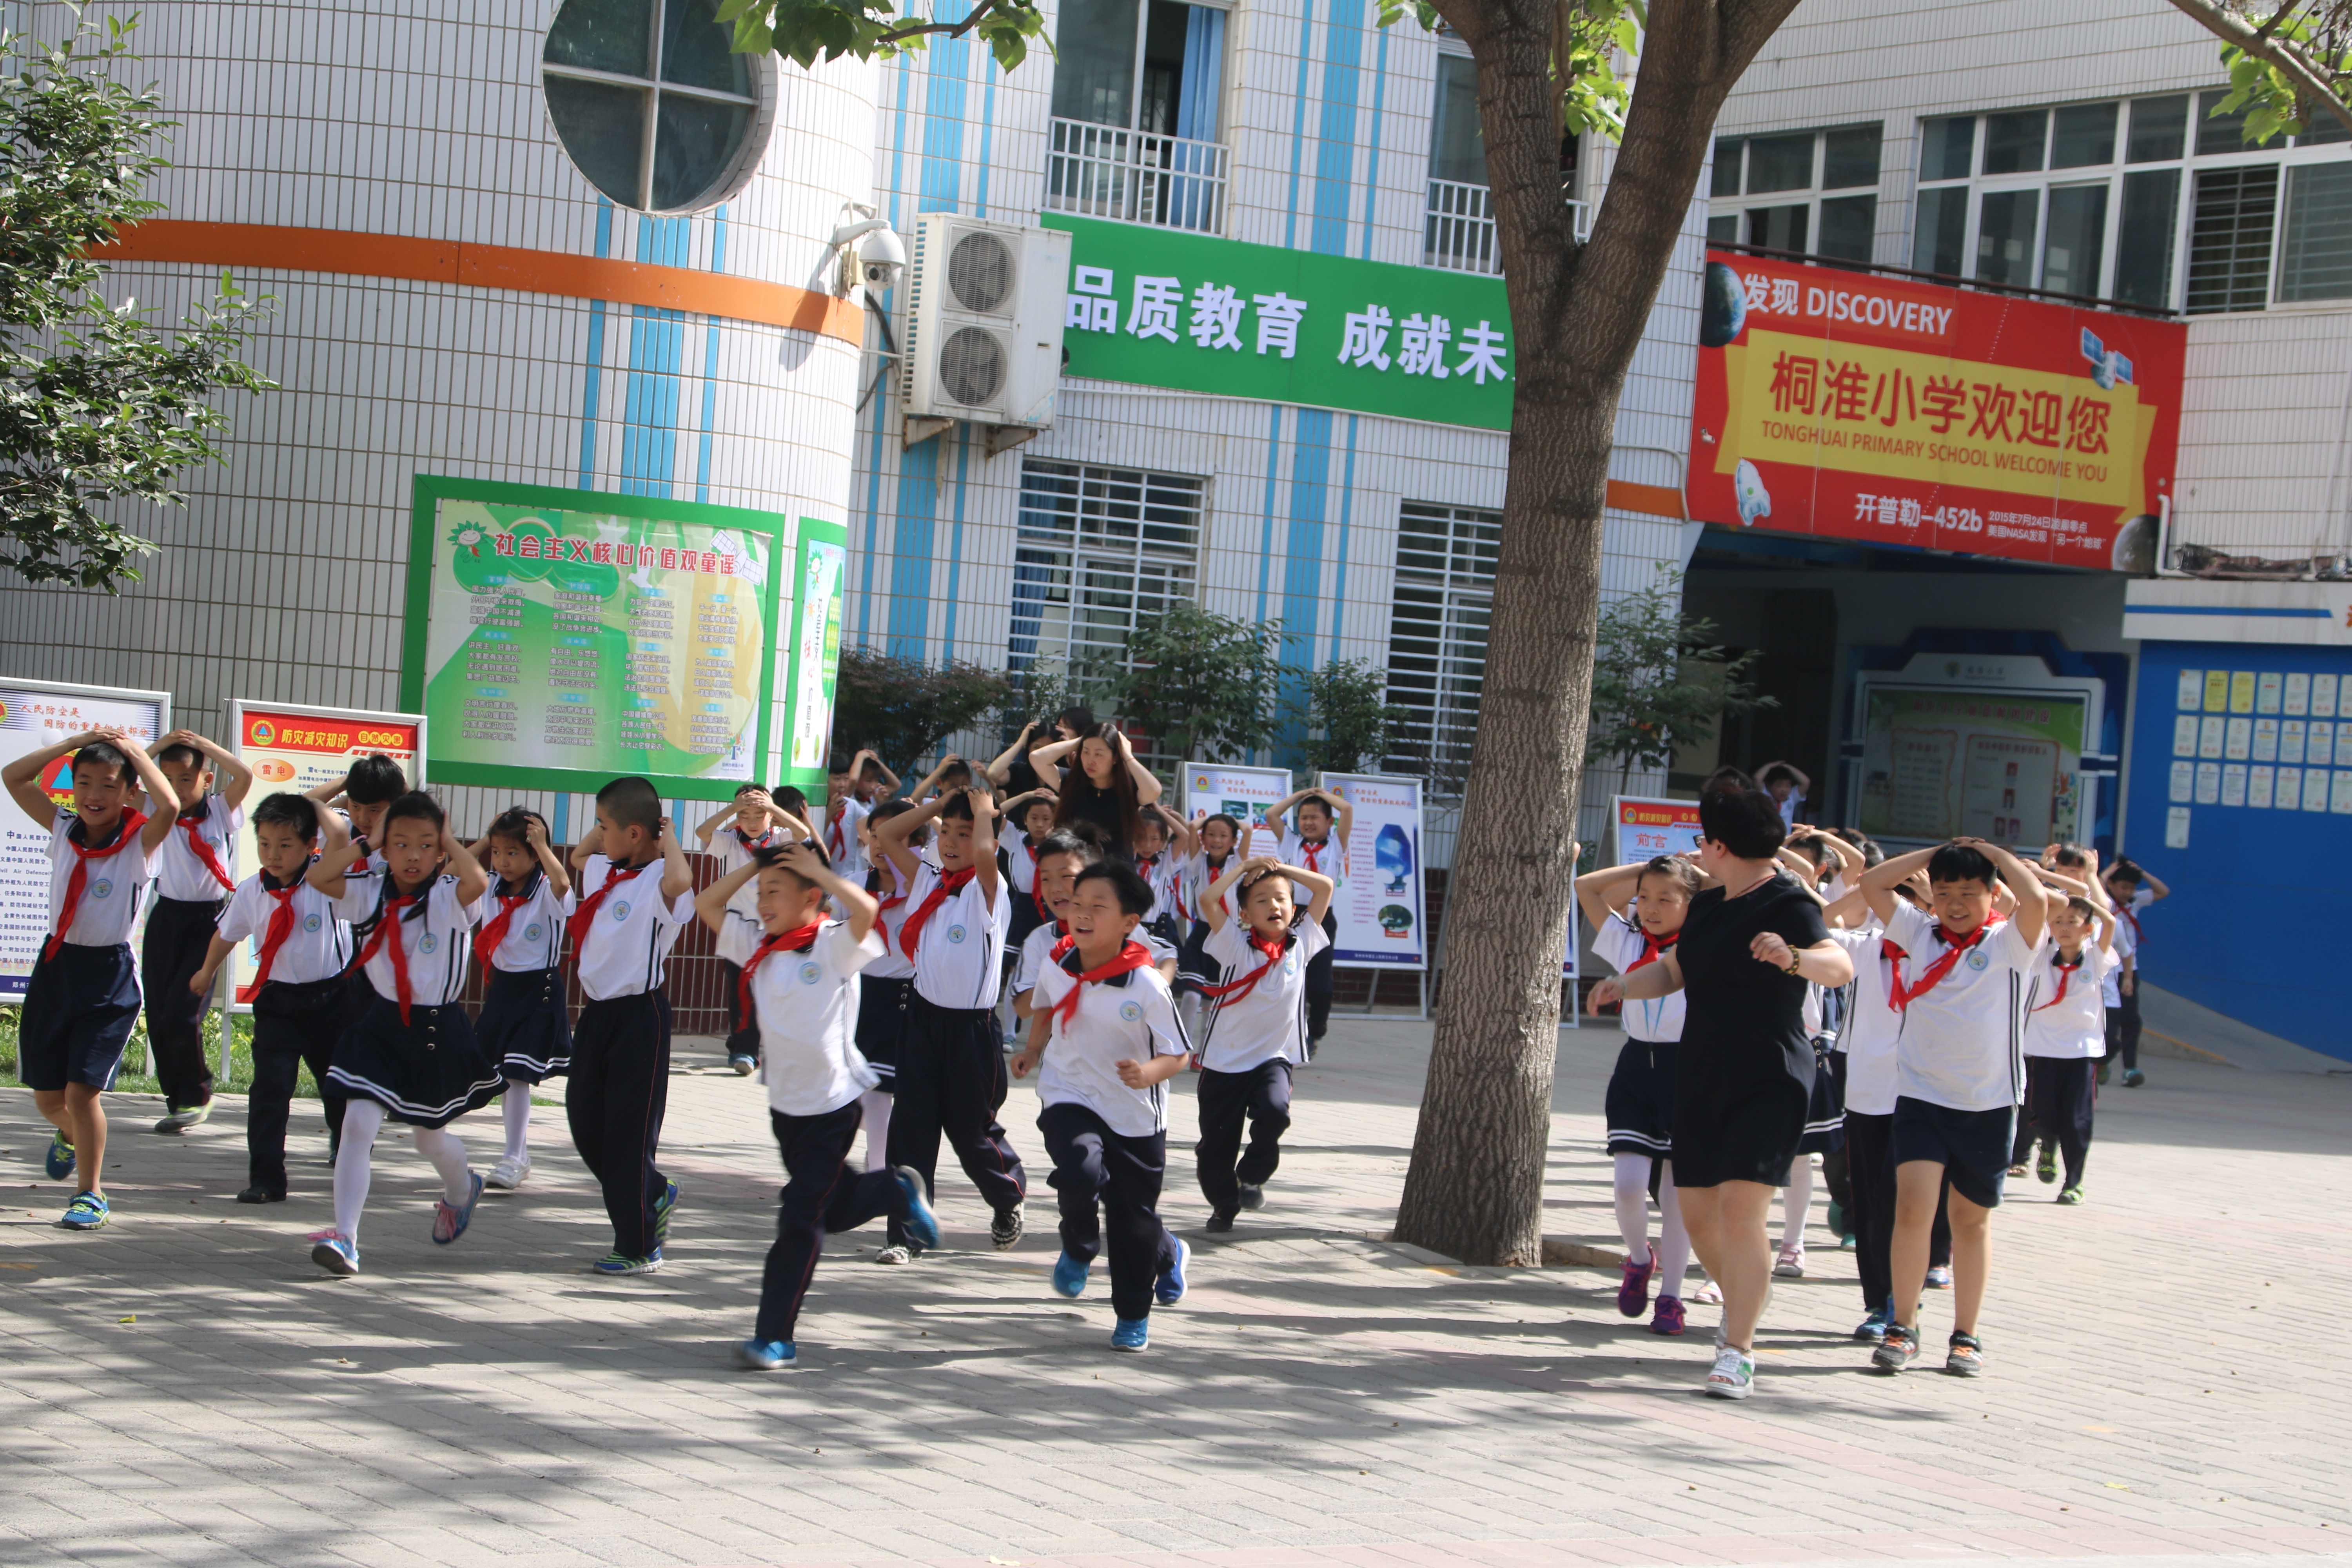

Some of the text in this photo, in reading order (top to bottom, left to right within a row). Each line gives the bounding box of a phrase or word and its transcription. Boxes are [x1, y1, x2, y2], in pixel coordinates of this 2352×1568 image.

[1744, 273, 1951, 336] 发现 DISCOVERY
[1065, 265, 1515, 386] 品质教育 成就未
[1769, 350, 2111, 455] 桐淮小学欢迎您
[1762, 420, 2108, 483] TONGHUAI PRIMARY SCHOOL WELCOME YOU
[1989, 511, 2089, 533] 2015年7月24日凌晨零点
[495, 533, 735, 575] 社会主义核心价值观童谣
[20, 704, 81, 718] 人民防空是
[281, 729, 348, 748] 防灾减灾知识
[359, 731, 402, 745] 自然灾害
[262, 764, 286, 776] 雷电
[1636, 833, 1668, 848] 前言
